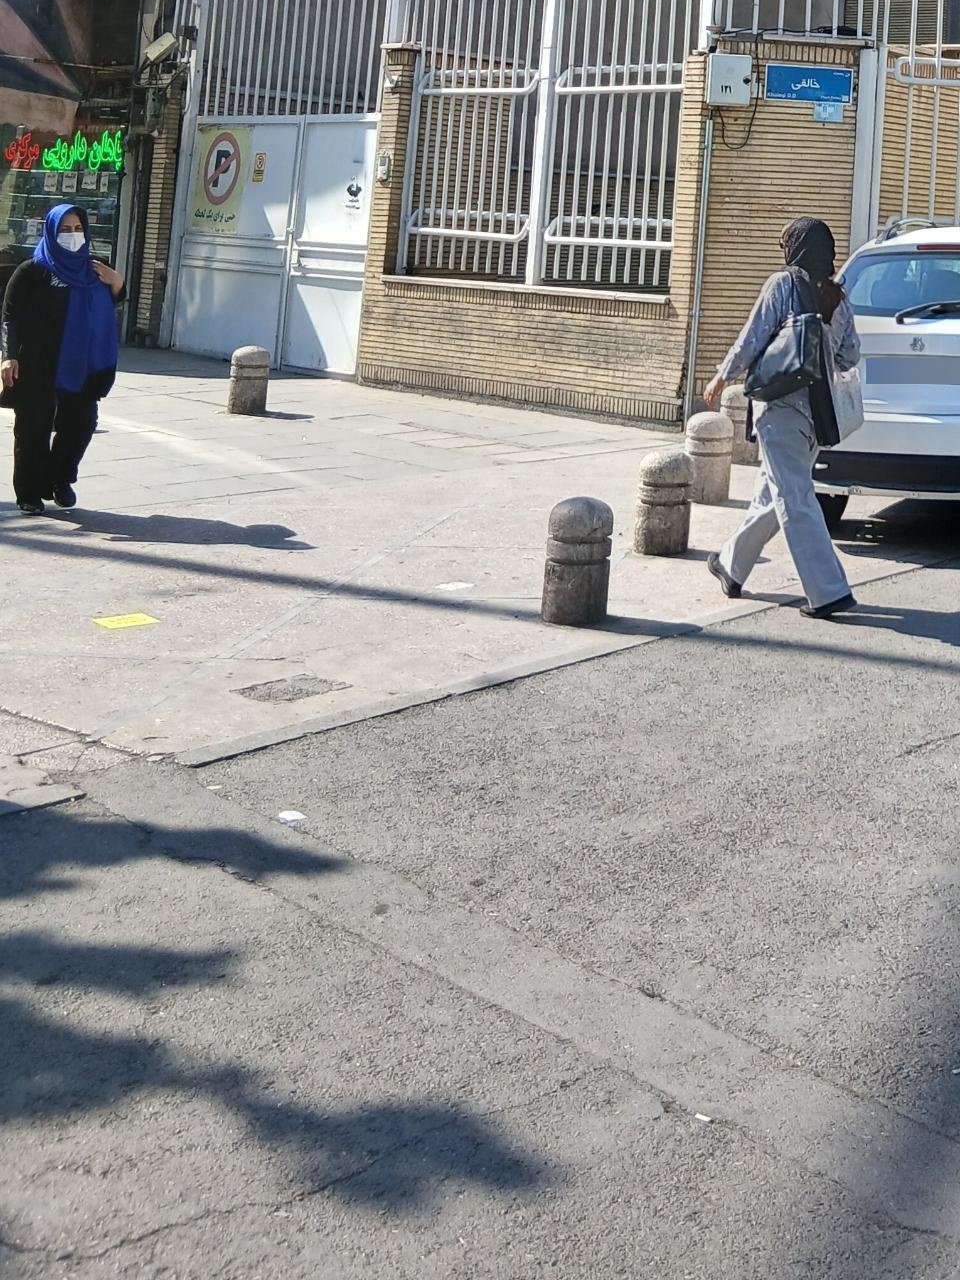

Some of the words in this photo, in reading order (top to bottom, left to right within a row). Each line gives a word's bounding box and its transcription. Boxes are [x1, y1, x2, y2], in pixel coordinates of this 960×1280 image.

[791, 78, 820, 90] خالقی
[5, 133, 40, 169] مرکزی
[42, 130, 87, 170] دارویی
